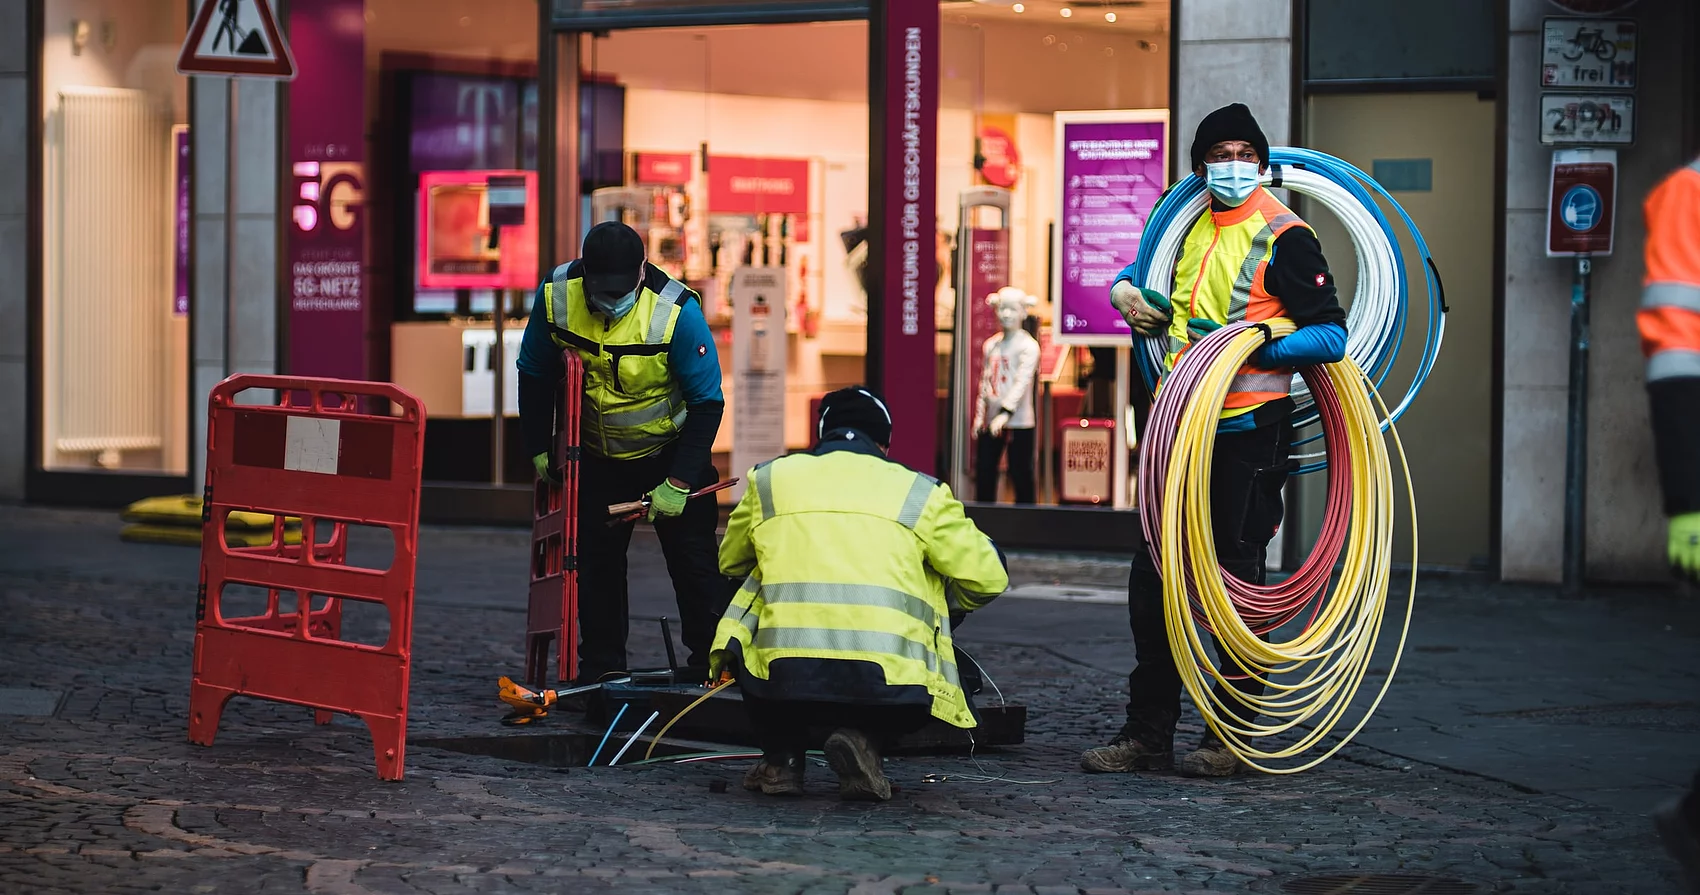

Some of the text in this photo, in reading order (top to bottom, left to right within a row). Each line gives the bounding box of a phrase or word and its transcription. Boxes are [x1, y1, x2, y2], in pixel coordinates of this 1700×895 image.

[1573, 65, 1604, 81] frei
[292, 163, 363, 233] 5G
[901, 27, 921, 335] BERATUNG FÜR GESCHÄFTSKUNDEN
[293, 277, 360, 296] 5G-NETZ
